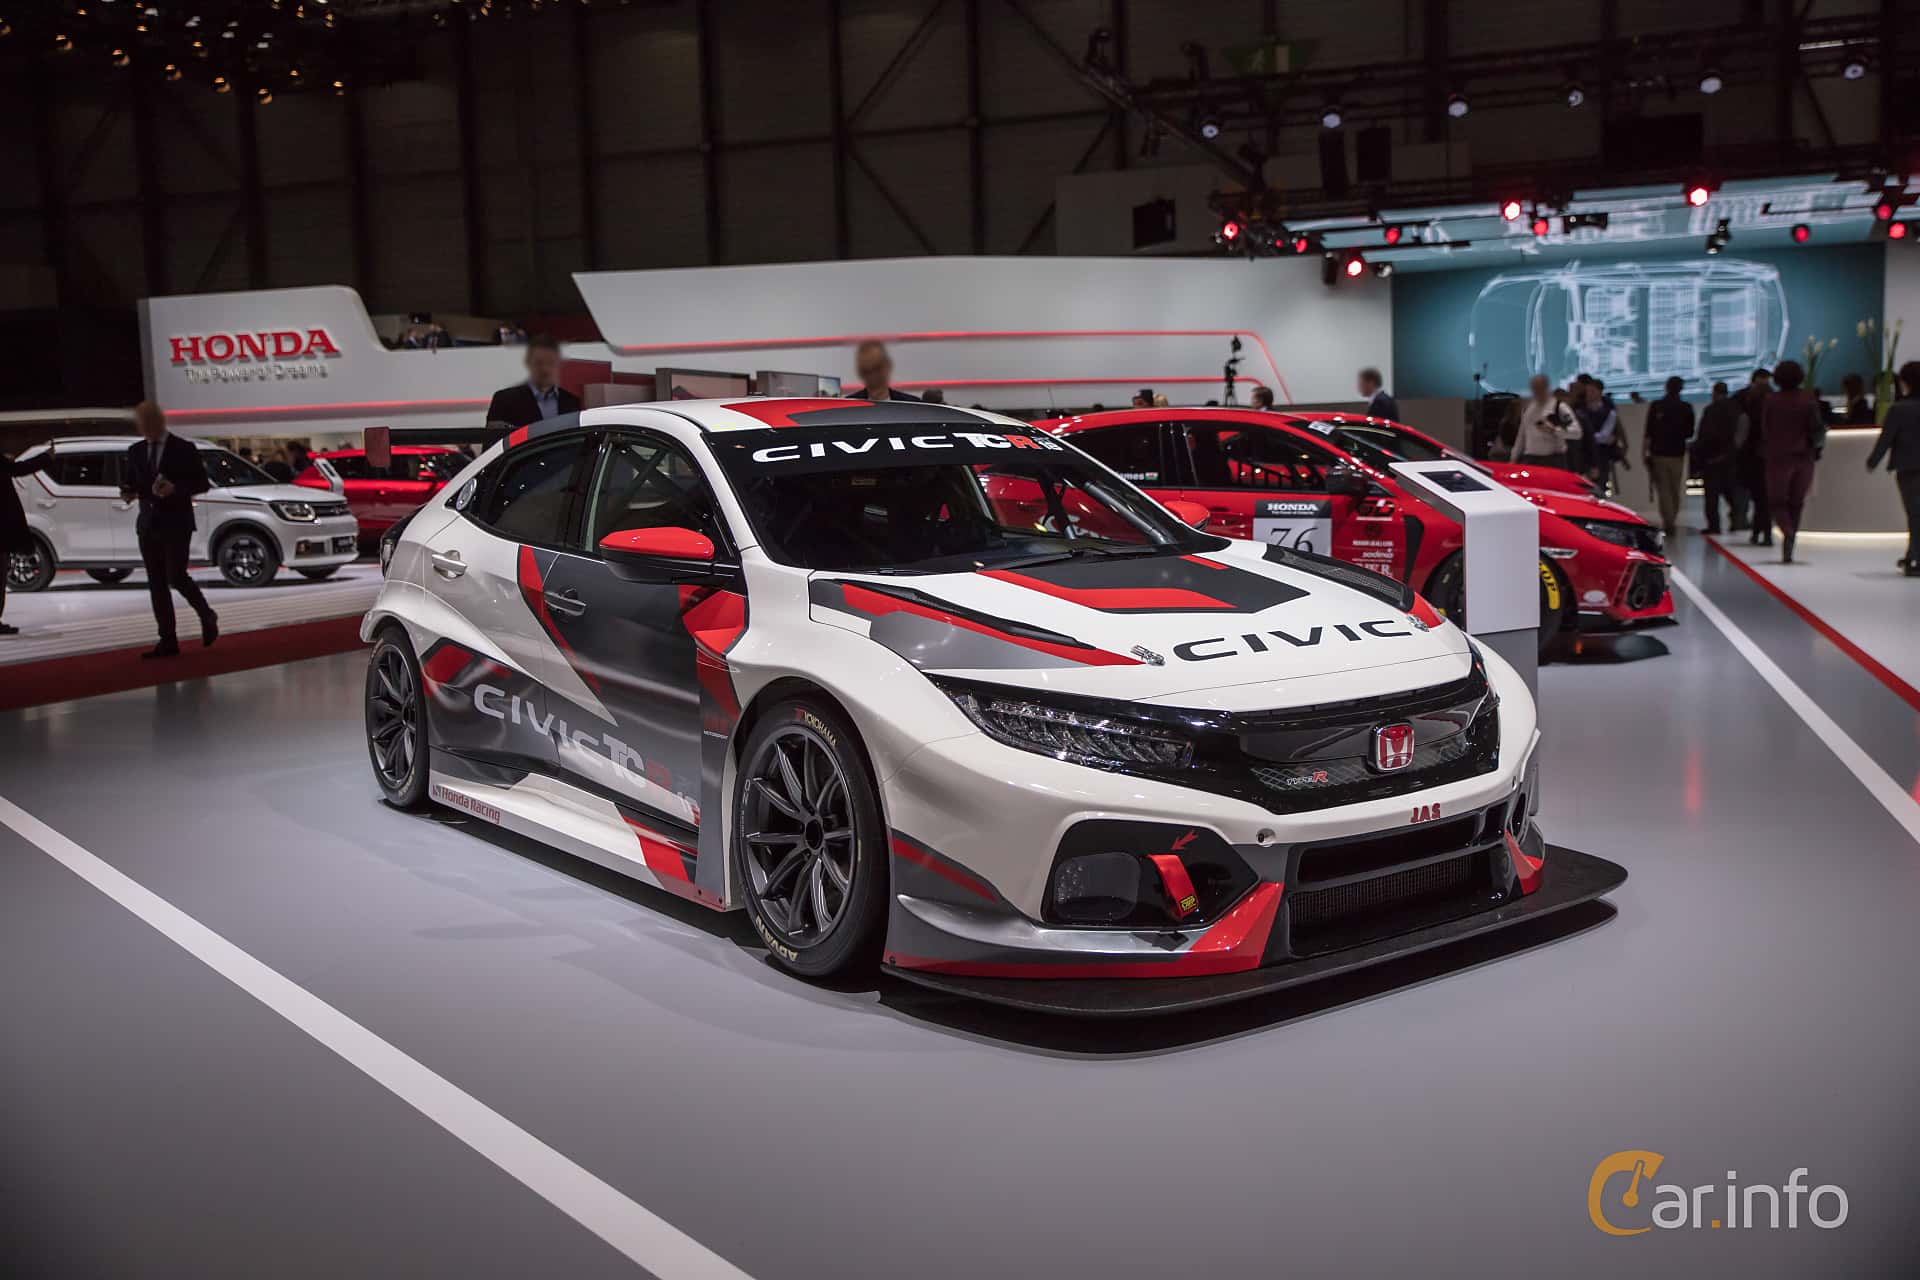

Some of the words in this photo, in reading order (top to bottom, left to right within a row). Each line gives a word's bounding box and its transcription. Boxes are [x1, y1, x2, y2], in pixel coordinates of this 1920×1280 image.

[168, 328, 340, 364] HONDA
[752, 433, 955, 463] CIVIC
[951, 432, 1044, 450] TCR
[1266, 503, 1320, 511] HONDA
[1270, 526, 1319, 553] 76
[1172, 619, 1413, 662] CIVIC
[473, 683, 602, 757] CIVIC
[804, 710, 838, 748] YOKOHAMA
[441, 786, 470, 808] Honda
[470, 798, 501, 825] Racing
[1410, 802, 1441, 824] JAS
[755, 914, 799, 962] ADVAN
